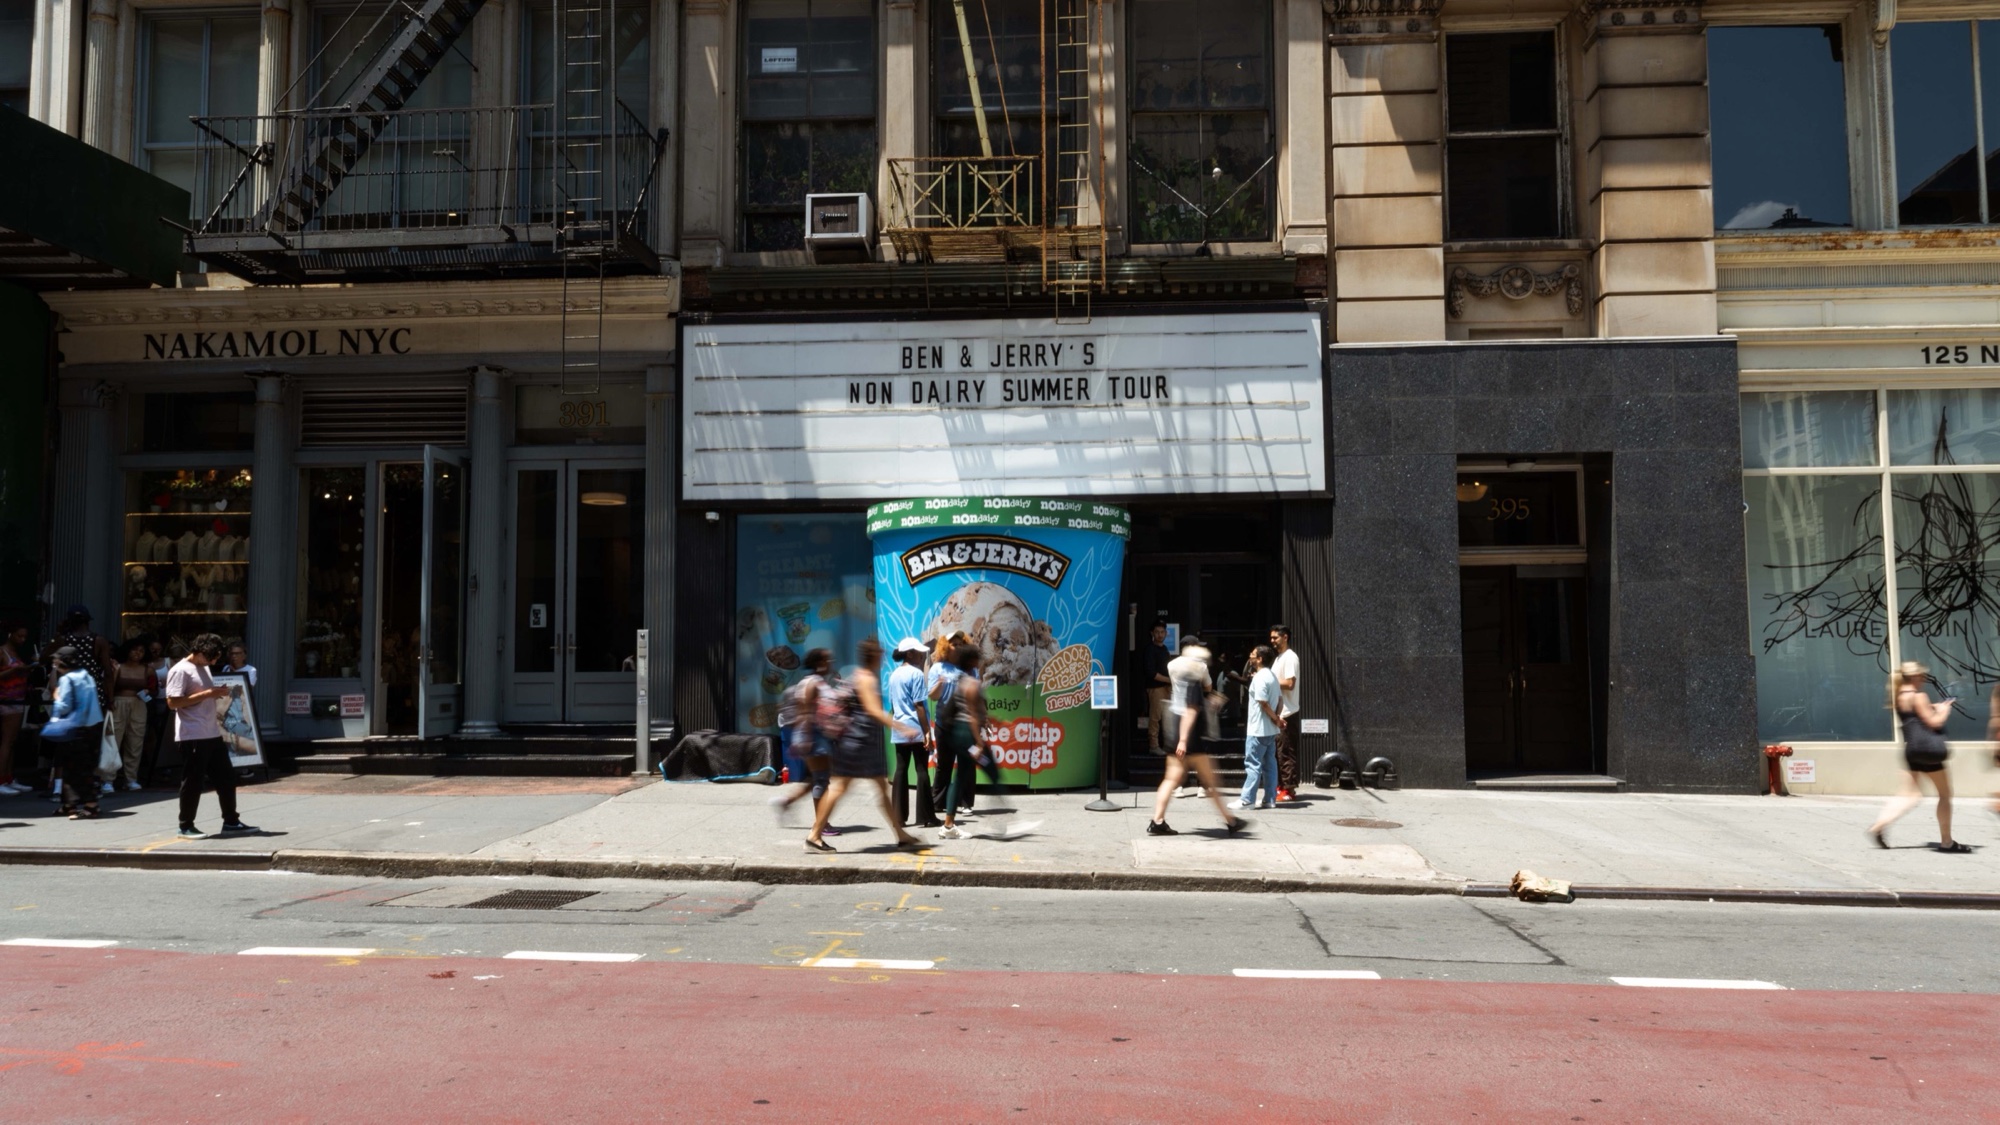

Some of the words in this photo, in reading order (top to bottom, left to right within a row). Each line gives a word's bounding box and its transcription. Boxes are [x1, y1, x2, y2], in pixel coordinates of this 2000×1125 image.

[143, 329, 327, 360] NAKAMOL
[338, 327, 411, 355] NYC
[902, 346, 943, 369] BEN
[960, 345, 972, 367] &
[990, 342, 1095, 368] JERRY'S
[1921, 345, 1969, 364] 125
[850, 382, 892, 404] NON
[912, 380, 985, 404] DAIRY
[1003, 377, 1090, 402] SUMMER
[1108, 375, 1169, 400] TOUR
[559, 400, 610, 427] 391
[1487, 498, 1530, 521] 395
[1910, 620, 1968, 639] QUIN
[1041, 646, 1090, 681] smooth
[1048, 694, 1073, 710] new
[1014, 722, 1061, 747] Chip
[990, 745, 1054, 770] Dough
